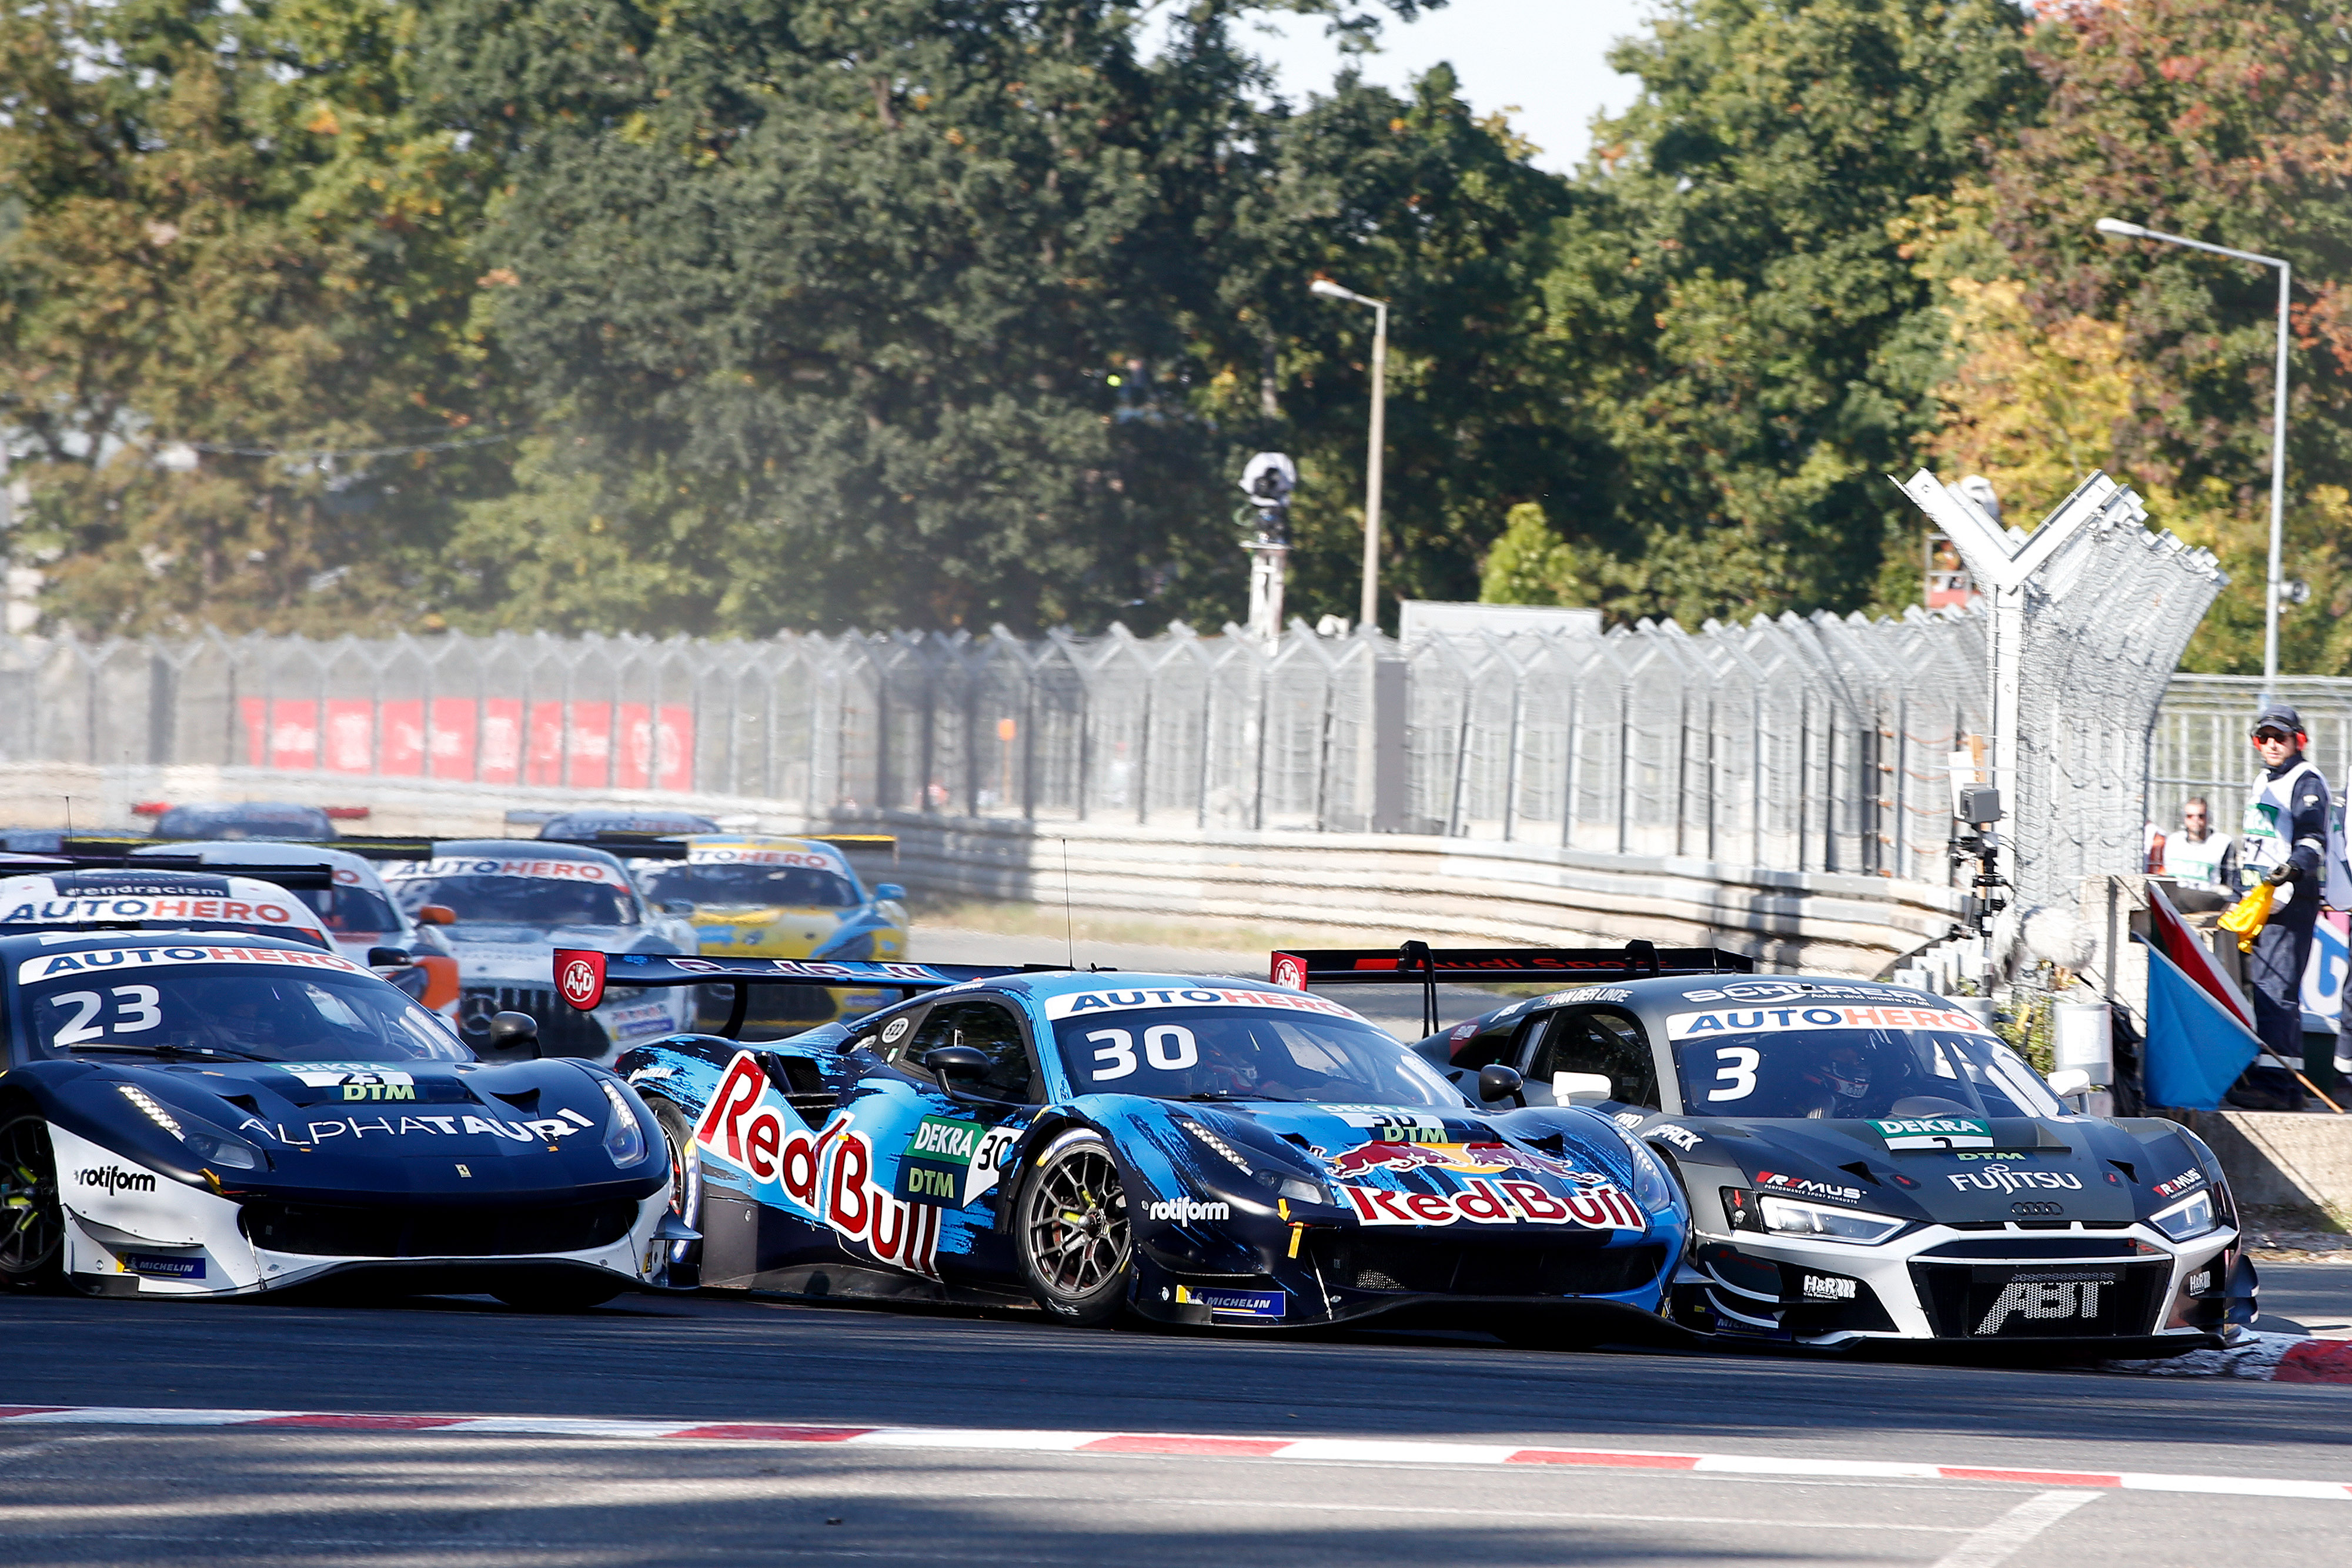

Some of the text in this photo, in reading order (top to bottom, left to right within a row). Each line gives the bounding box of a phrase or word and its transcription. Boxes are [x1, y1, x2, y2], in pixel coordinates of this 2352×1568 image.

[696, 850, 827, 868] TOHERO
[2, 900, 290, 923] AUTOHERO
[42, 948, 355, 976] AUTOHERO
[1071, 990, 1354, 1018] AUTOHERO
[1682, 984, 1928, 1002] SCHERER
[50, 984, 162, 1048] 23
[1686, 1009, 1979, 1034] AUTOHERO
[1085, 1024, 1198, 1081] 30
[280, 1063, 395, 1072] DEKRA
[1707, 1047, 1760, 1102] 3
[343, 1084, 416, 1101] DTM
[1317, 1105, 1424, 1114] DEKRA
[238, 1108, 594, 1145] ALPHATAURI
[1383, 1126, 1448, 1144] DTM
[1877, 1119, 1984, 1134] DEKRA
[914, 1122, 974, 1158] DEKRA
[697, 1054, 850, 1209] Red
[828, 1132, 943, 1281] Bull
[1956, 1152, 2026, 1161] DTM
[79, 1165, 156, 1196] rotiform
[908, 1167, 954, 1199] DTM
[1766, 1174, 1863, 1200] REMUS
[1947, 1166, 2083, 1195] FUJITSU
[2160, 1169, 2202, 1196] REMUS
[1150, 1196, 1230, 1228] rotiform
[1347, 1181, 1643, 1228] Red Bull
[139, 1261, 194, 1272] MICHELIN
[1803, 1275, 1838, 1296] H&R
[2189, 1273, 2204, 1293] H&R
[1206, 1296, 1271, 1309] MICHELIN
[1975, 1272, 2116, 1335] ABT
